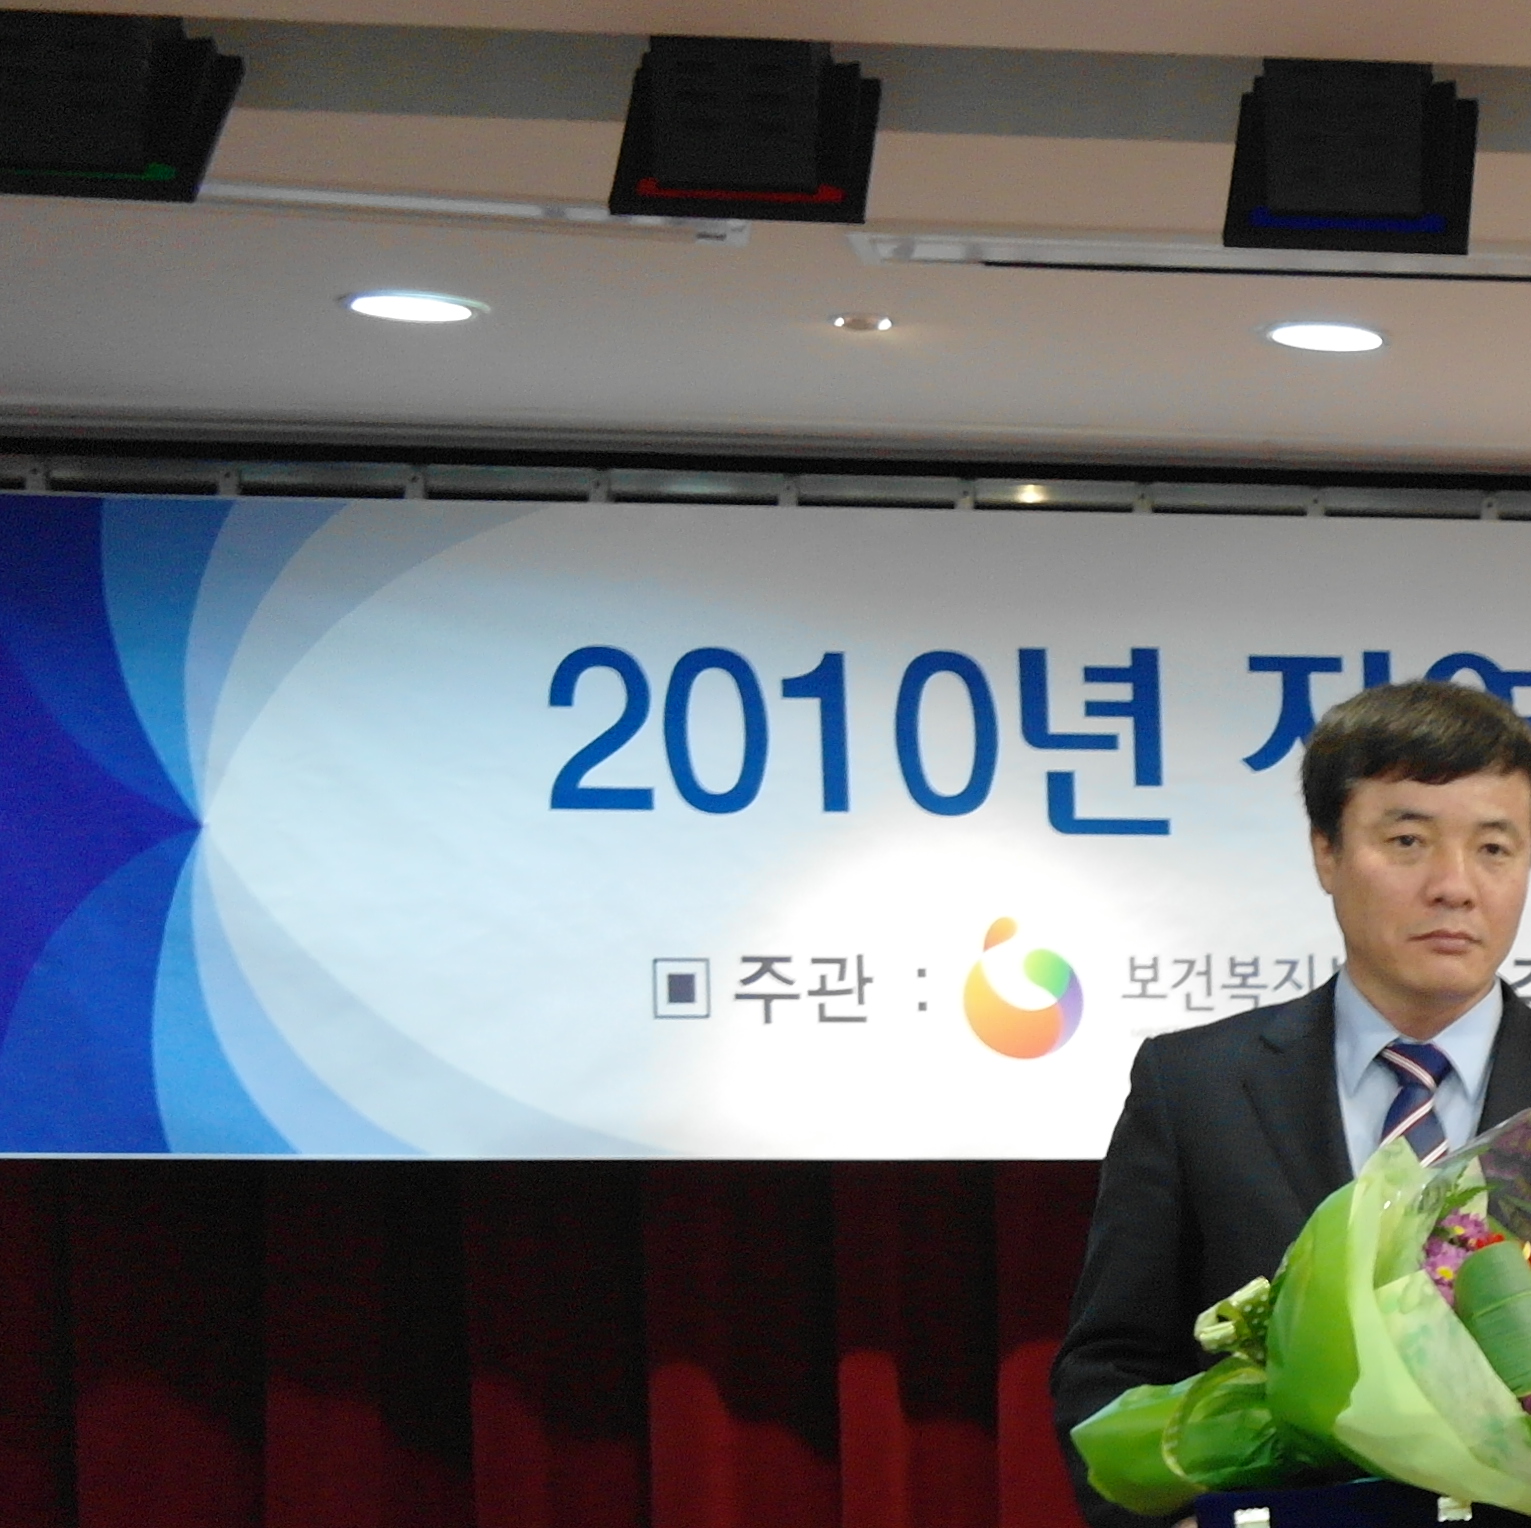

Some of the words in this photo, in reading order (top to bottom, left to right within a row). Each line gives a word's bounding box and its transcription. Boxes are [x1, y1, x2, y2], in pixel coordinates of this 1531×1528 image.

[548, 644, 1171, 835] 2010년
[733, 954, 873, 1024] 주관
[1121, 952, 1342, 1012] 보건복지
